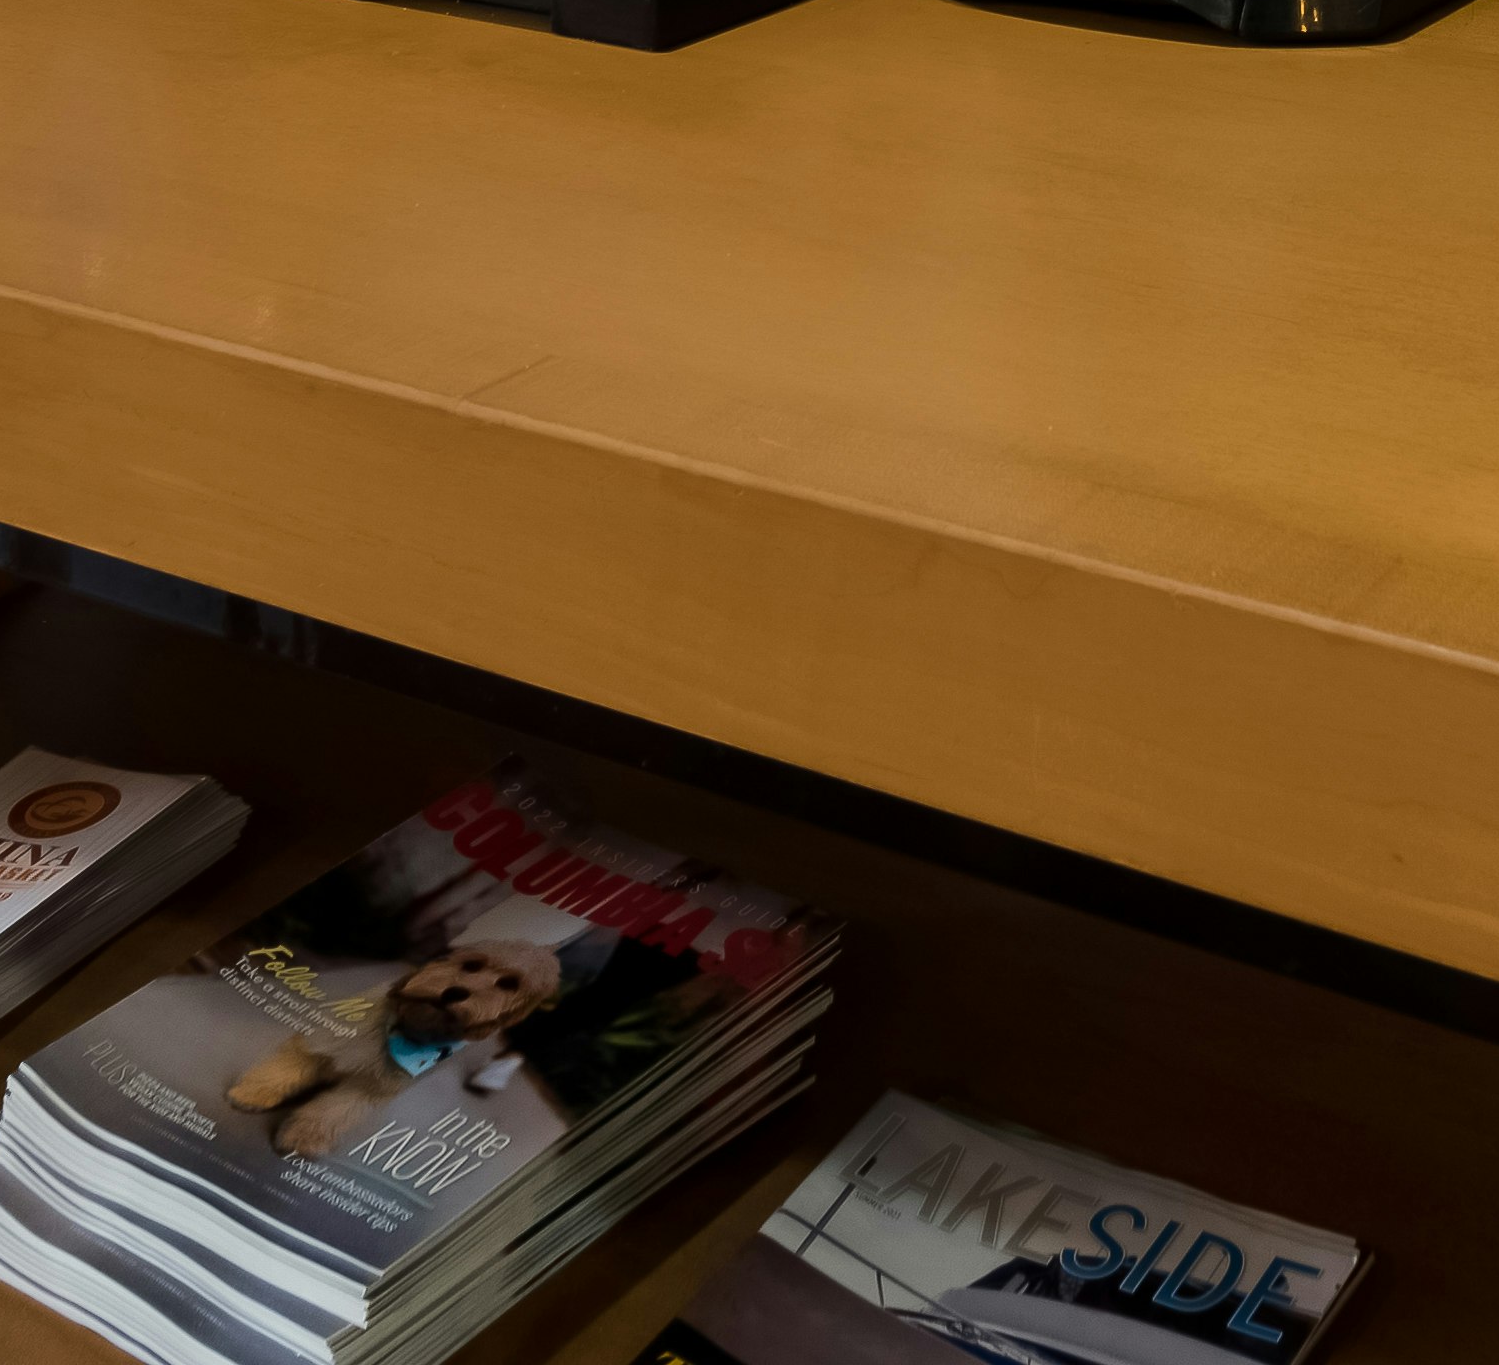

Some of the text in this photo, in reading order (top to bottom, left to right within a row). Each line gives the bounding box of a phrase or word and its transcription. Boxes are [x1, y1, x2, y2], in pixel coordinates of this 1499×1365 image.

[423, 781, 715, 959] COLUMBIA
[497, 783, 566, 832] 2022
[719, 895, 805, 937] GUIDE
[219, 967, 314, 1035] distinct districts
[235, 955, 263, 982] Take
[273, 990, 309, 1013] stroll
[306, 1009, 356, 1038] through
[248, 944, 374, 1022] Follow Me
[82, 1040, 130, 1083] PLUS
[350, 1122, 479, 1193] KNOW
[455, 1120, 509, 1157] the
[280, 1171, 397, 1232] share insider tips
[837, 1111, 1323, 1346] LAKESIDE
